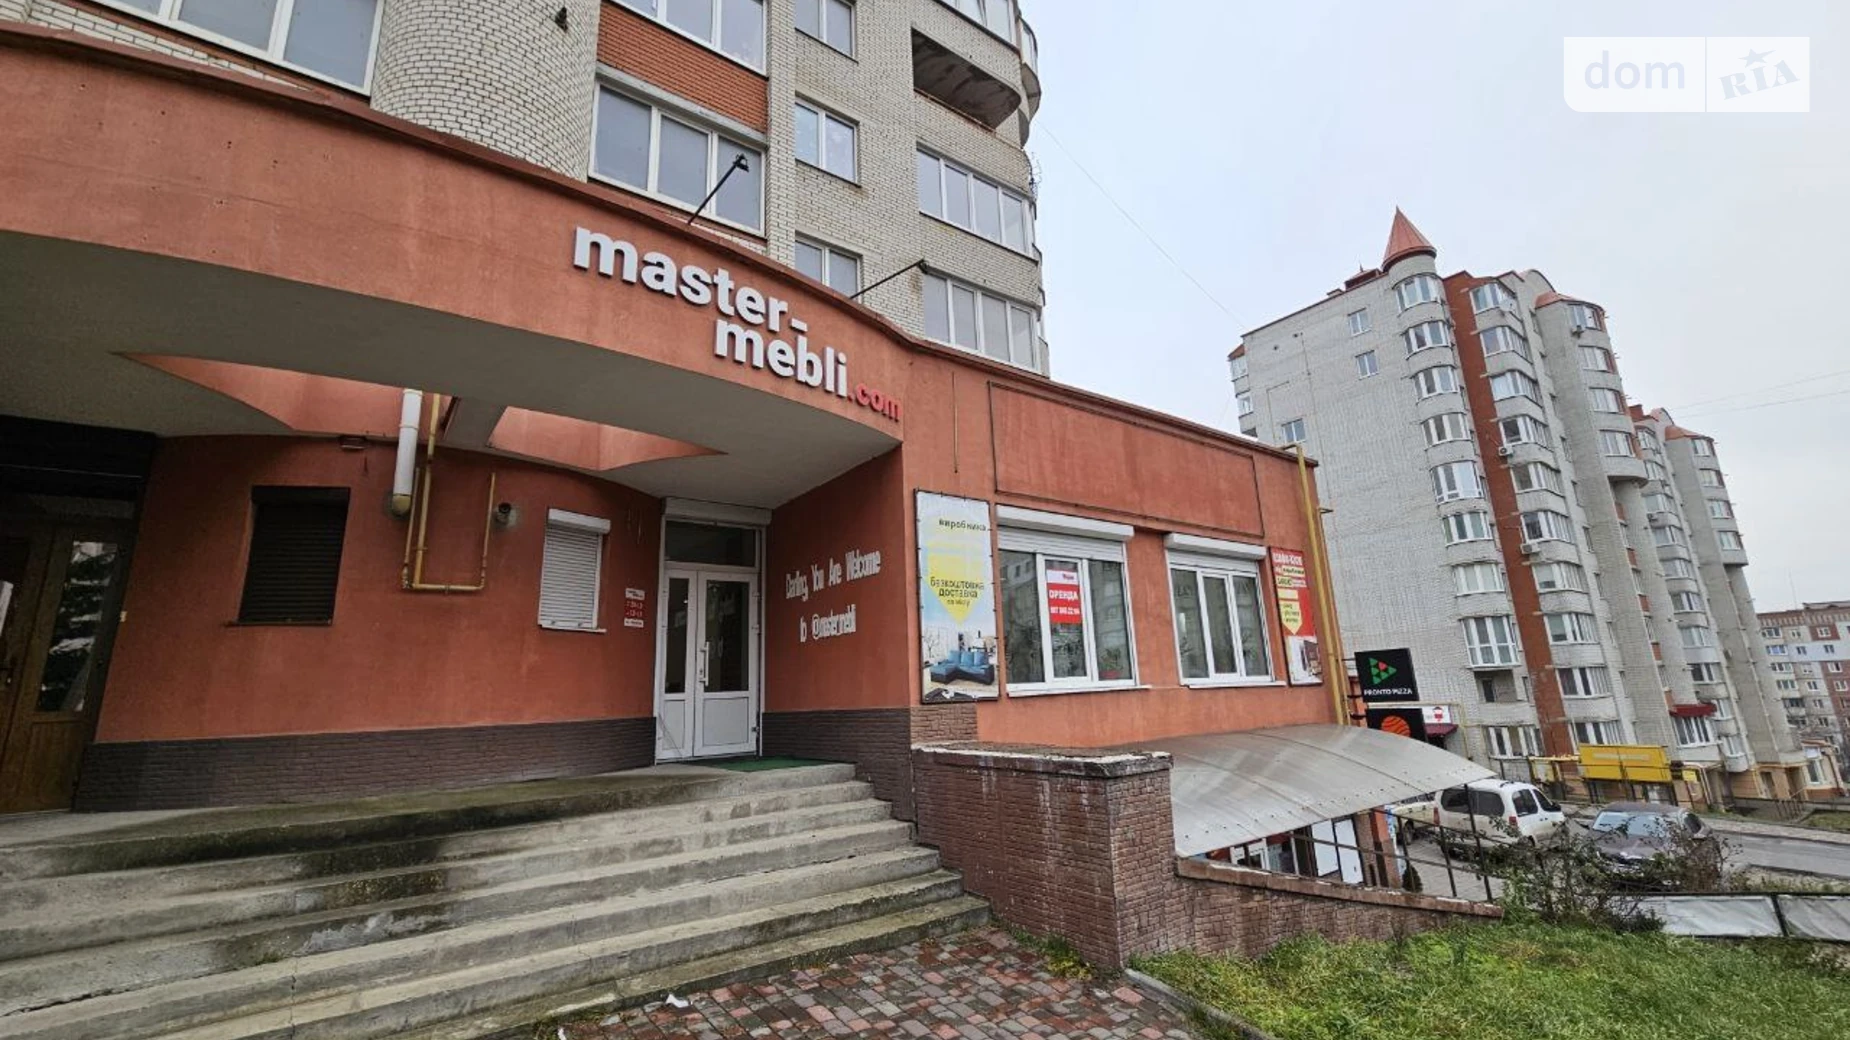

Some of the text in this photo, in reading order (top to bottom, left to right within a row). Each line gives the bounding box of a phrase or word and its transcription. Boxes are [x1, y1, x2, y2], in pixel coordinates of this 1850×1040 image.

[574, 226, 807, 332] master-
[938, 518, 986, 531] виробника
[1049, 590, 1079, 601] ОРЕНДА
[1364, 688, 1391, 696] PRONTO
